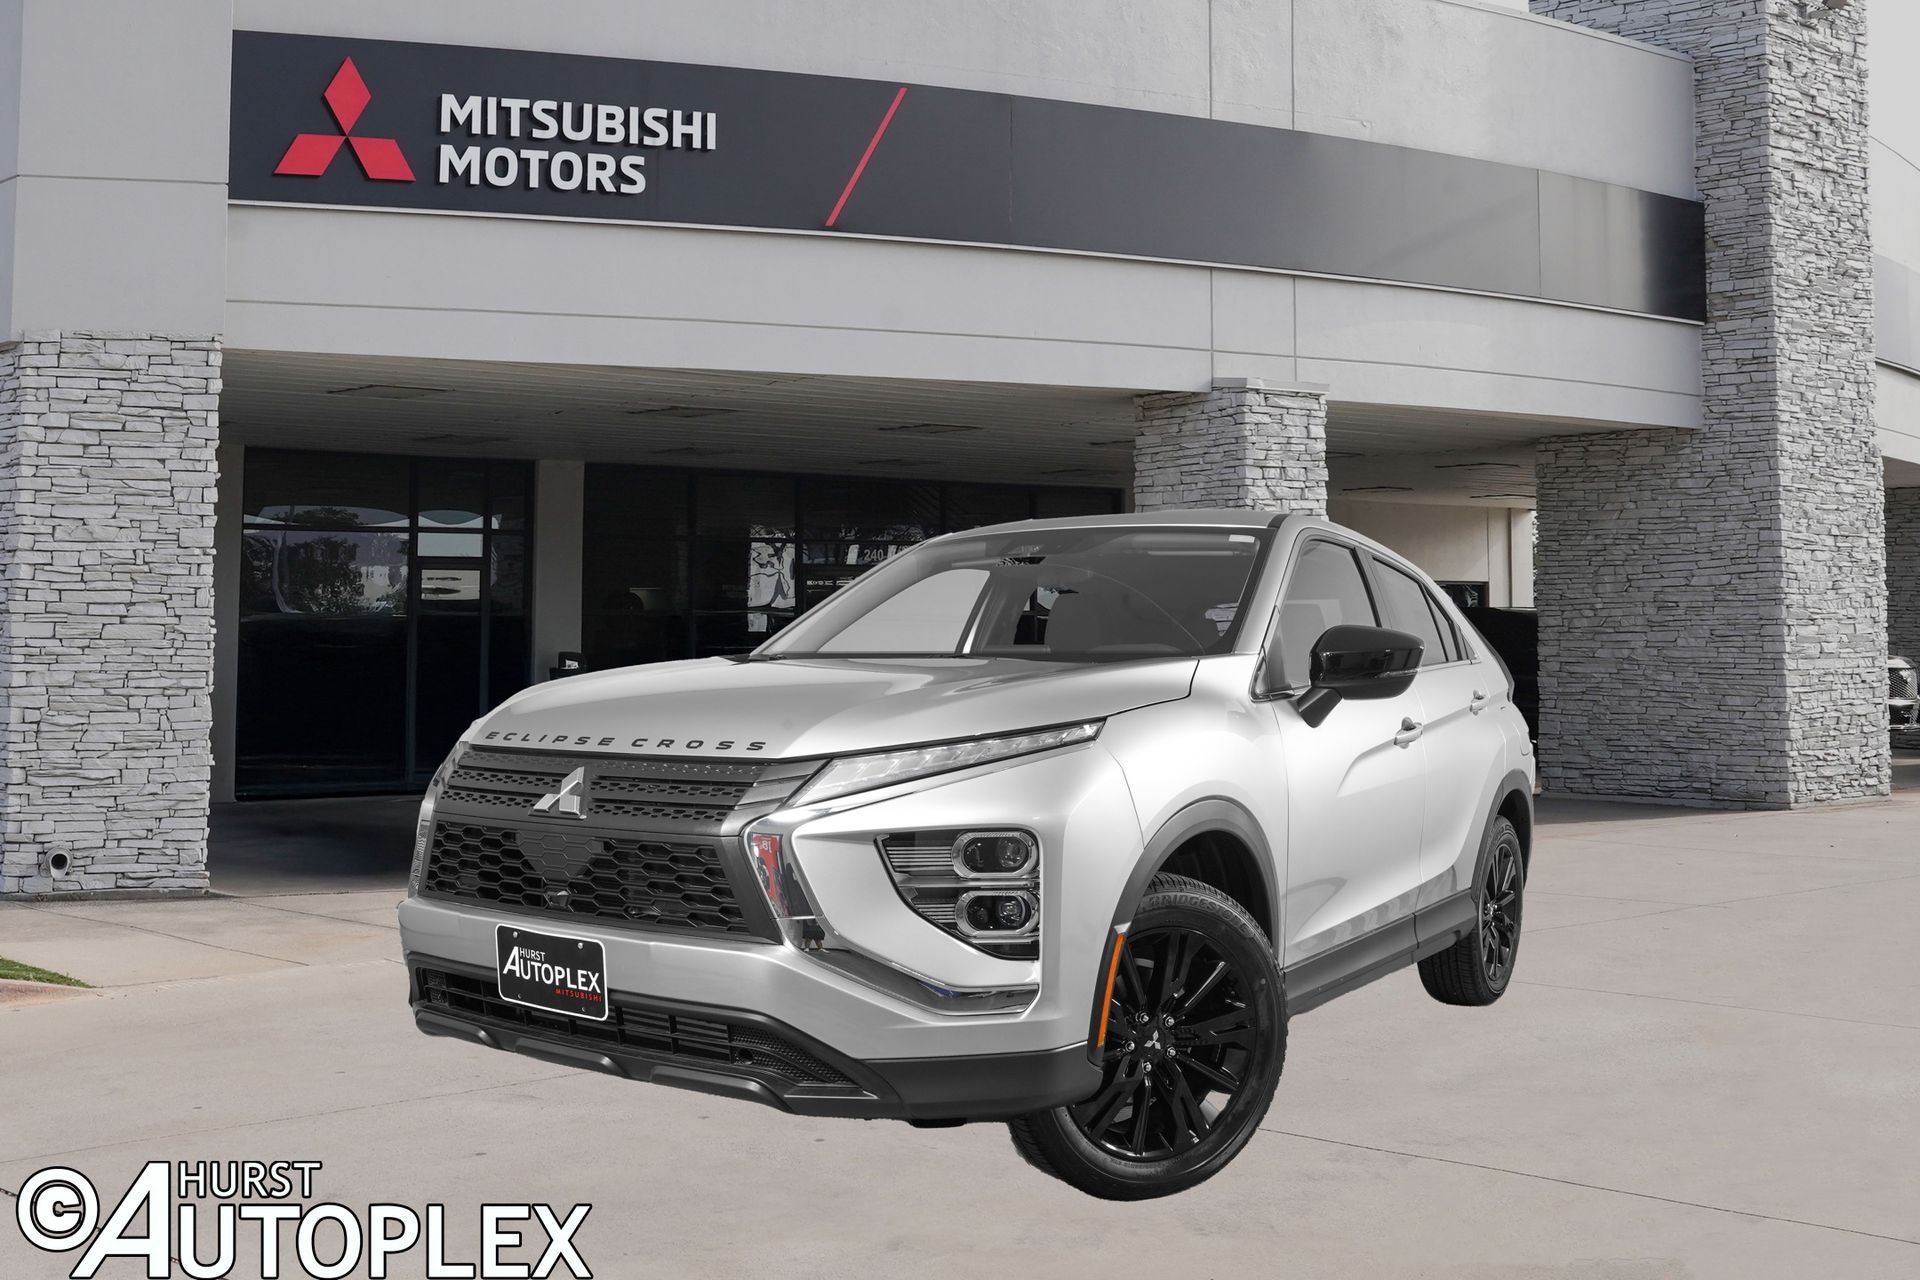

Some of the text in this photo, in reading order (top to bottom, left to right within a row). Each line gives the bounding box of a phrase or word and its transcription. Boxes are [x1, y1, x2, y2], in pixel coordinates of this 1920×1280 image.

[439, 92, 718, 151] MITSUBISHI
[438, 144, 647, 195] MOTORS
[485, 731, 767, 751] ECLIPSE CROSS
[502, 946, 601, 993] AUTOPLEX
[519, 947, 546, 962] HURST
[554, 987, 603, 1002] MITSUBISHI
